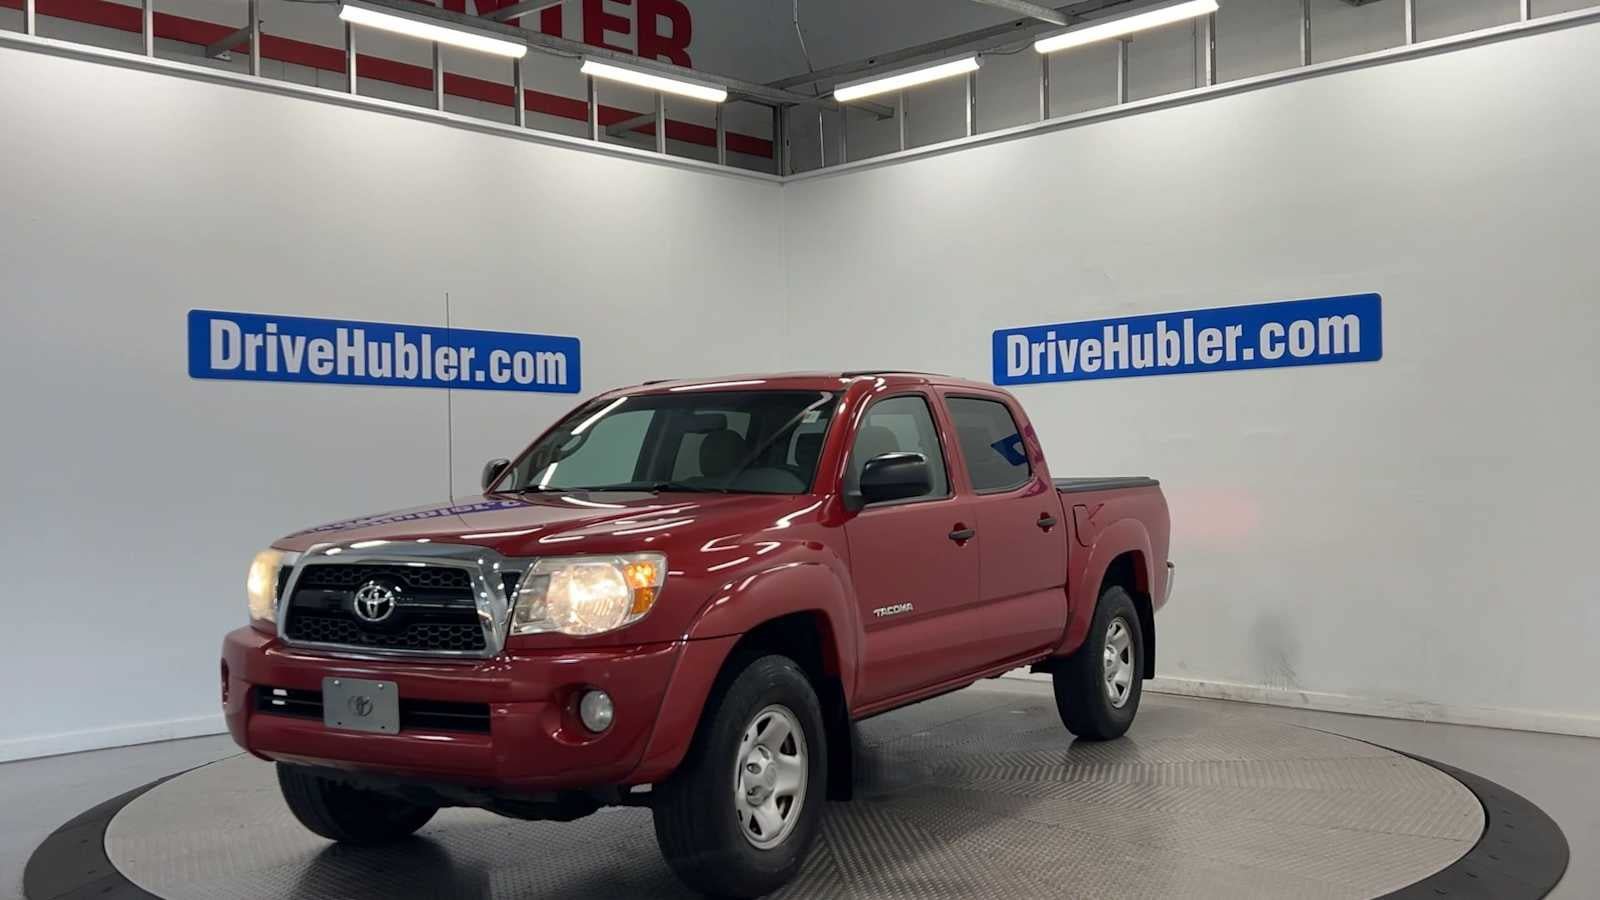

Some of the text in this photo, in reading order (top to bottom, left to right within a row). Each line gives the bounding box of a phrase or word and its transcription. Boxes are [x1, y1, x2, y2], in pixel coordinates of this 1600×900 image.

[209, 318, 567, 386] DriveHubler.com
[1006, 313, 1361, 377] DriveHubler.com
[873, 602, 914, 617] TACOMA
